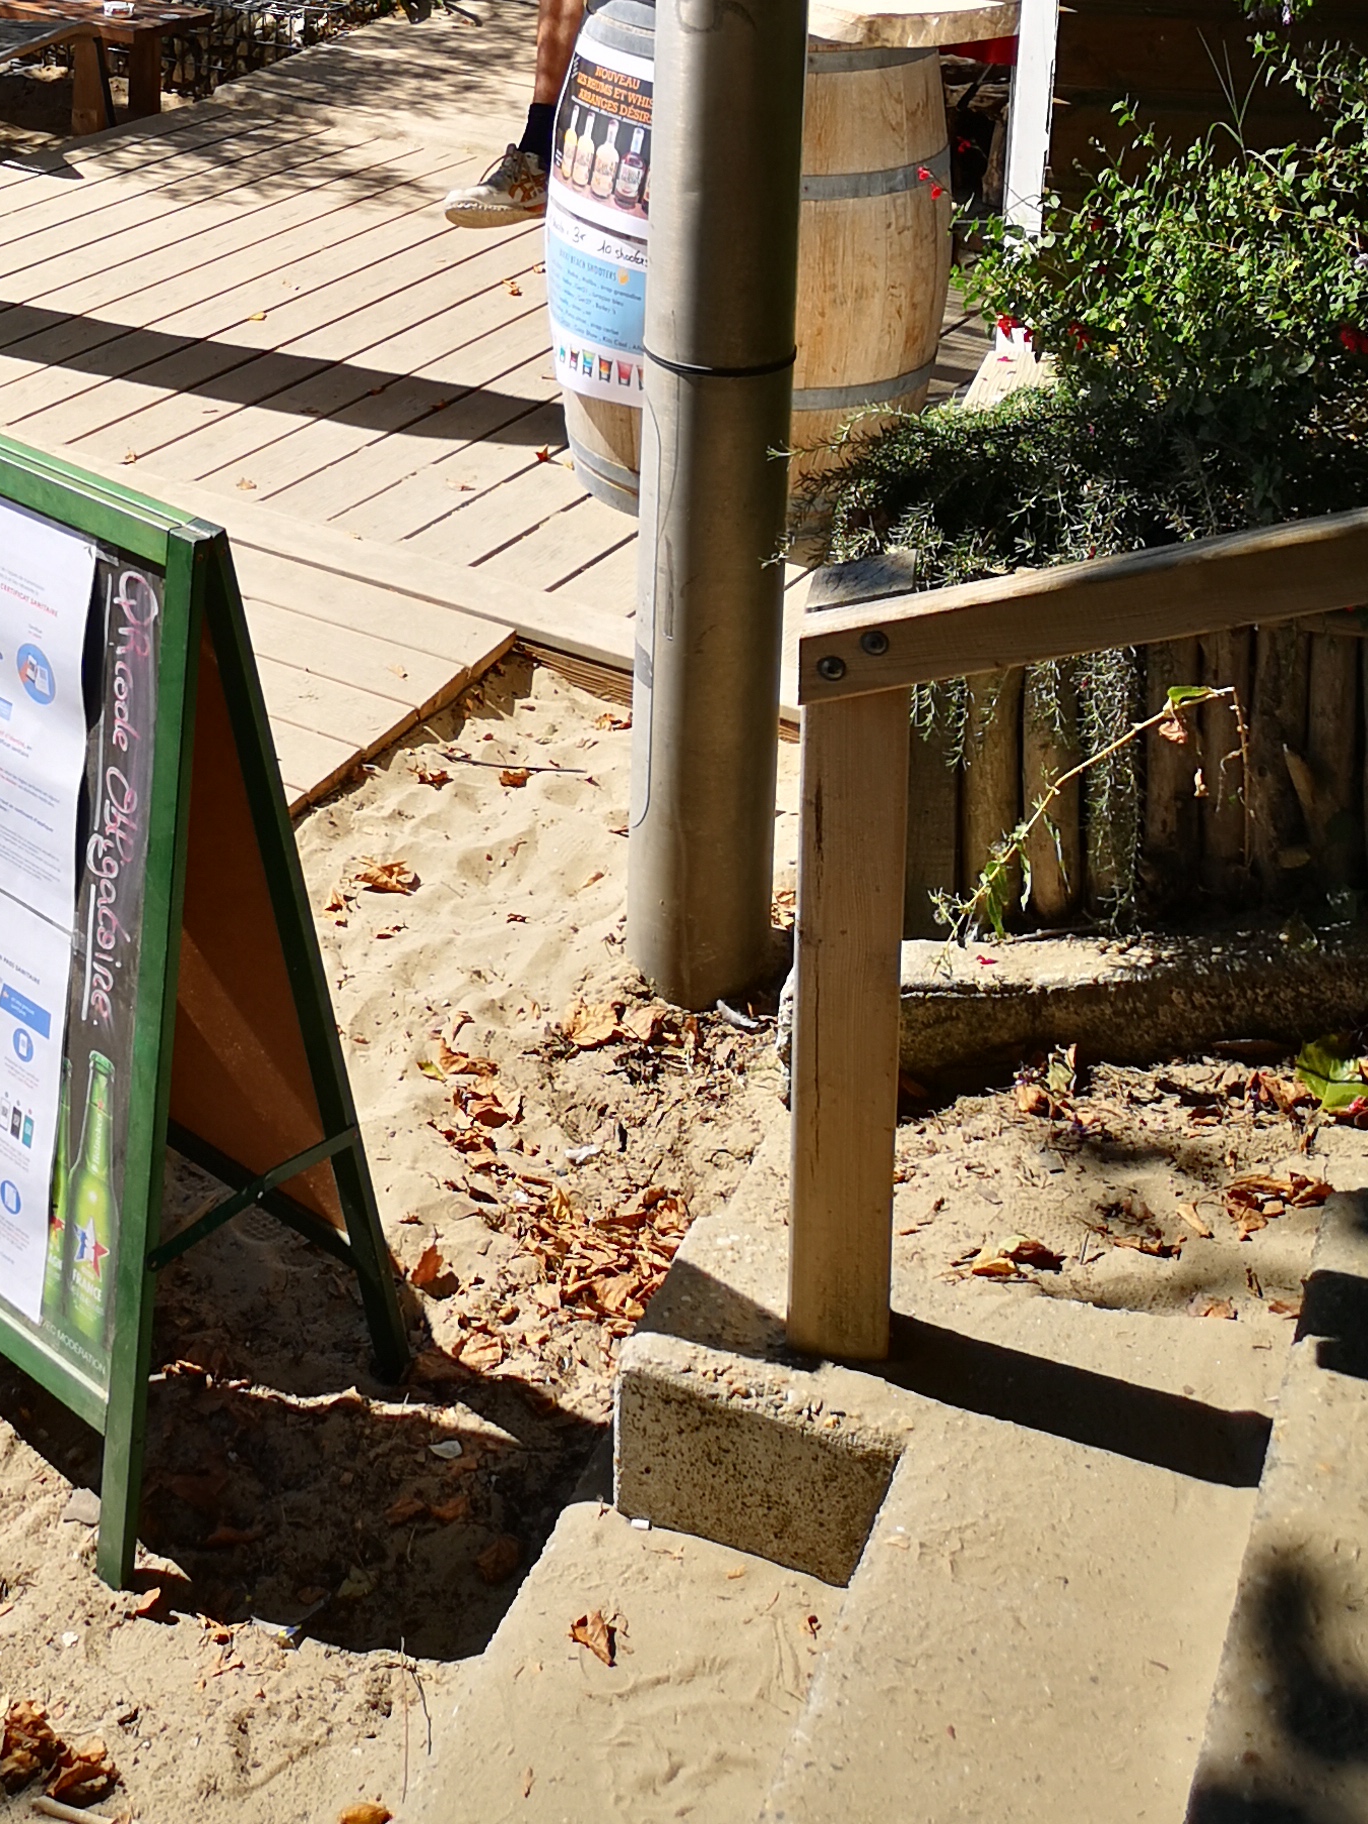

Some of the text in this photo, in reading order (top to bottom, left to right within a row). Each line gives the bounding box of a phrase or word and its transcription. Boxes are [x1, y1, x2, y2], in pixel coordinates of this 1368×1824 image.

[595, 66, 640, 90] NOUVEAU
[613, 87, 627, 101] ET
[627, 91, 653, 110] WHIS
[618, 104, 652, 123] DÉSIR
[597, 239, 612, 254] 10
[0, 582, 30, 603] CERTIFICAT
[30, 597, 58, 618] SANITAIRE
[15, 963, 41, 985] SANITAIRE
[72, 1268, 102, 1302] FRANCE
[57, 1329, 106, 1375] MODÉRATION
